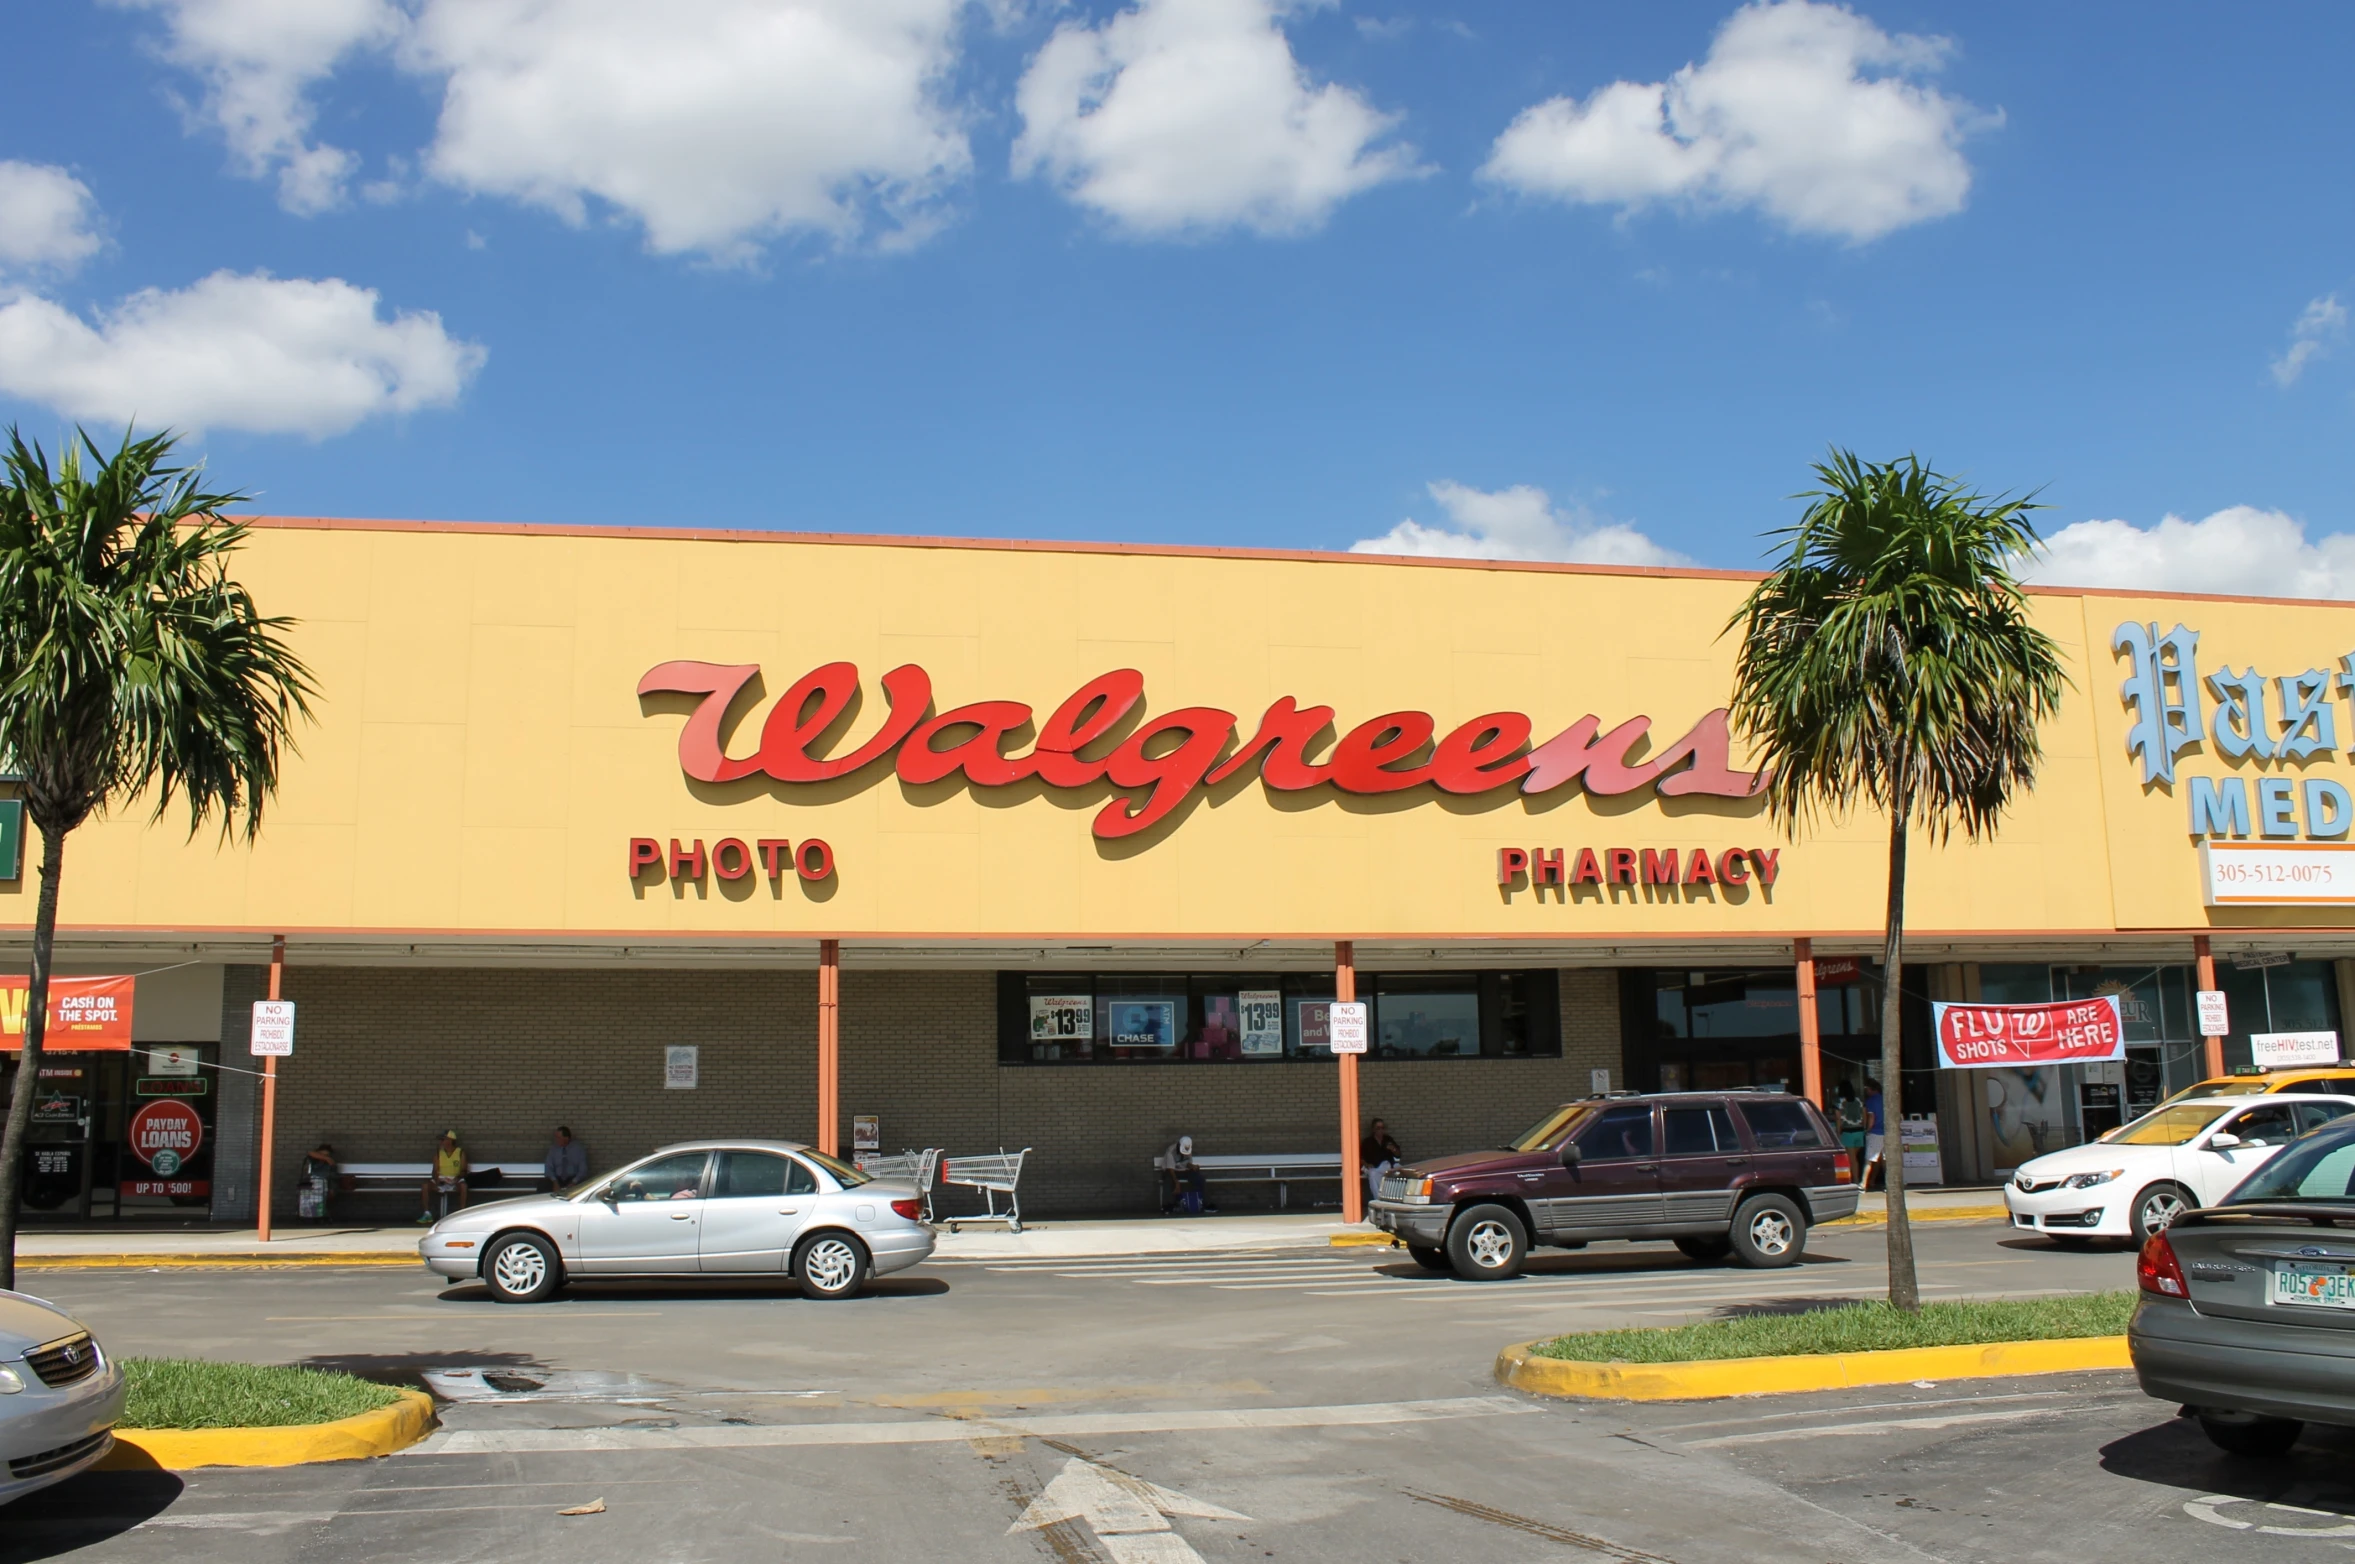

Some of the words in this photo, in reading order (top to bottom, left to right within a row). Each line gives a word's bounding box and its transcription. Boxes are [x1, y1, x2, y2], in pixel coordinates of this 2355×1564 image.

[636, 660, 1774, 838] Walgreens
[2189, 776, 2354, 837] MED
[628, 837, 835, 882] PHOTO
[1497, 847, 1781, 886] PHARMACY
[2216, 864, 2333, 883] 305-512-0075
[62, 996, 95, 1008] CASH
[97, 996, 115, 1008] ON
[1044, 998, 1088, 1007] Walgreens
[1241, 992, 1278, 1001] Walgreens
[2205, 994, 2218, 1002] NO
[265, 1005, 282, 1015] NO
[1340, 1006, 1356, 1015] NO
[2201, 1003, 2225, 1011] PARKING
[58, 1009, 82, 1021] THE
[85, 1009, 118, 1021] SPOT.
[256, 1016, 291, 1026] PARKING
[1162, 1006, 1171, 1025] ATM
[1333, 1016, 1364, 1025] PARKING
[2067, 1005, 2098, 1025] ARE
[1950, 1009, 2005, 1039] FLU
[1303, 1027, 1323, 1037] and
[2057, 1022, 2114, 1050] HERE
[1117, 1034, 1155, 1043] CHASE
[1957, 1038, 2008, 1060] SHOTS
[140, 1080, 202, 1093] LOANS
[146, 1118, 188, 1130] PAYDAY
[141, 1131, 192, 1148] LOANS
[136, 1183, 150, 1193] UP
[152, 1183, 164, 1193] TO
